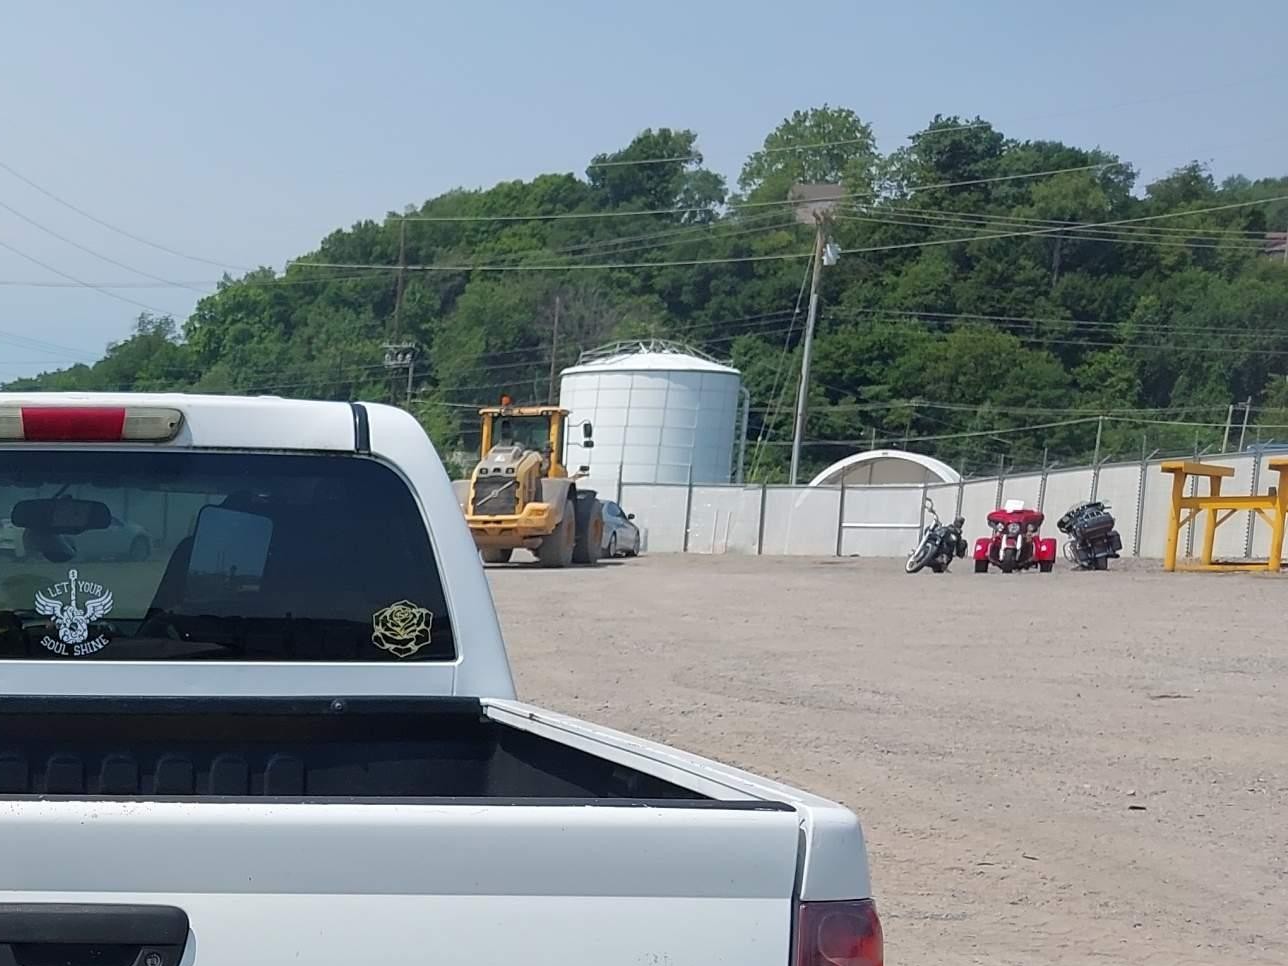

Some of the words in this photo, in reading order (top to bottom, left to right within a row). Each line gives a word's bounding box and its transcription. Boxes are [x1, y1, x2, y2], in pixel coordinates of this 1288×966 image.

[47, 582, 69, 598] LET
[78, 580, 103, 597] YOUR
[40, 635, 69, 655] SOUL
[73, 634, 109, 656] SHINE
